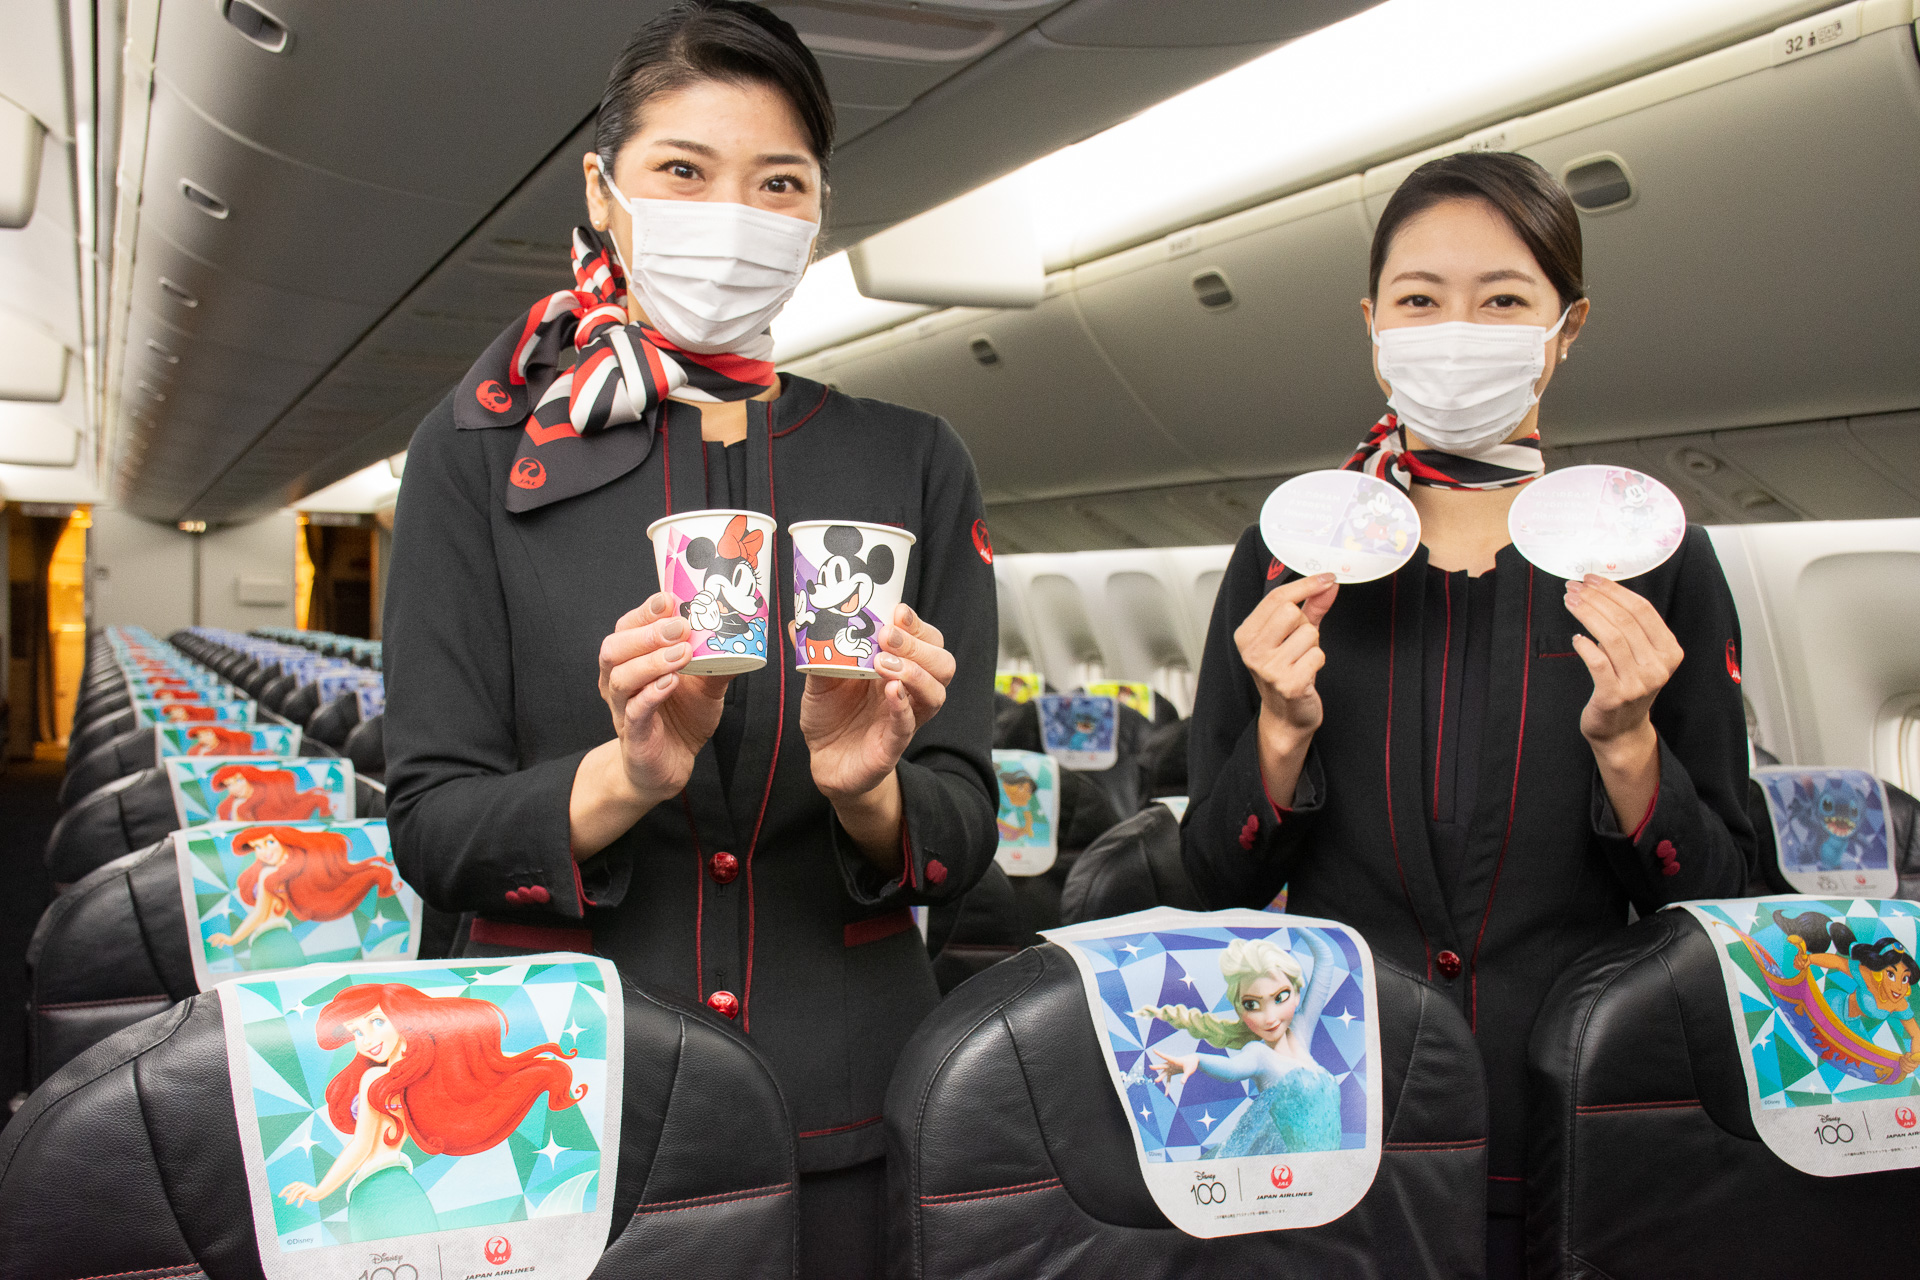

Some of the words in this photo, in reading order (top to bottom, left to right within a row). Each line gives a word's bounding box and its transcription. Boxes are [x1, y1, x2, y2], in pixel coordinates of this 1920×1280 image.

[1785, 35, 1803, 55] 32
[1818, 1114, 1841, 1123] Disney
[1814, 1123, 1854, 1145] 100
[1194, 1170, 1216, 1182] Disney
[1190, 1181, 1227, 1205] 100
[369, 1252, 403, 1264] Disney
[492, 1255, 508, 1263] JAL
[464, 1272, 492, 1280] JAPAN
[494, 1266, 536, 1277] AIRLINES
